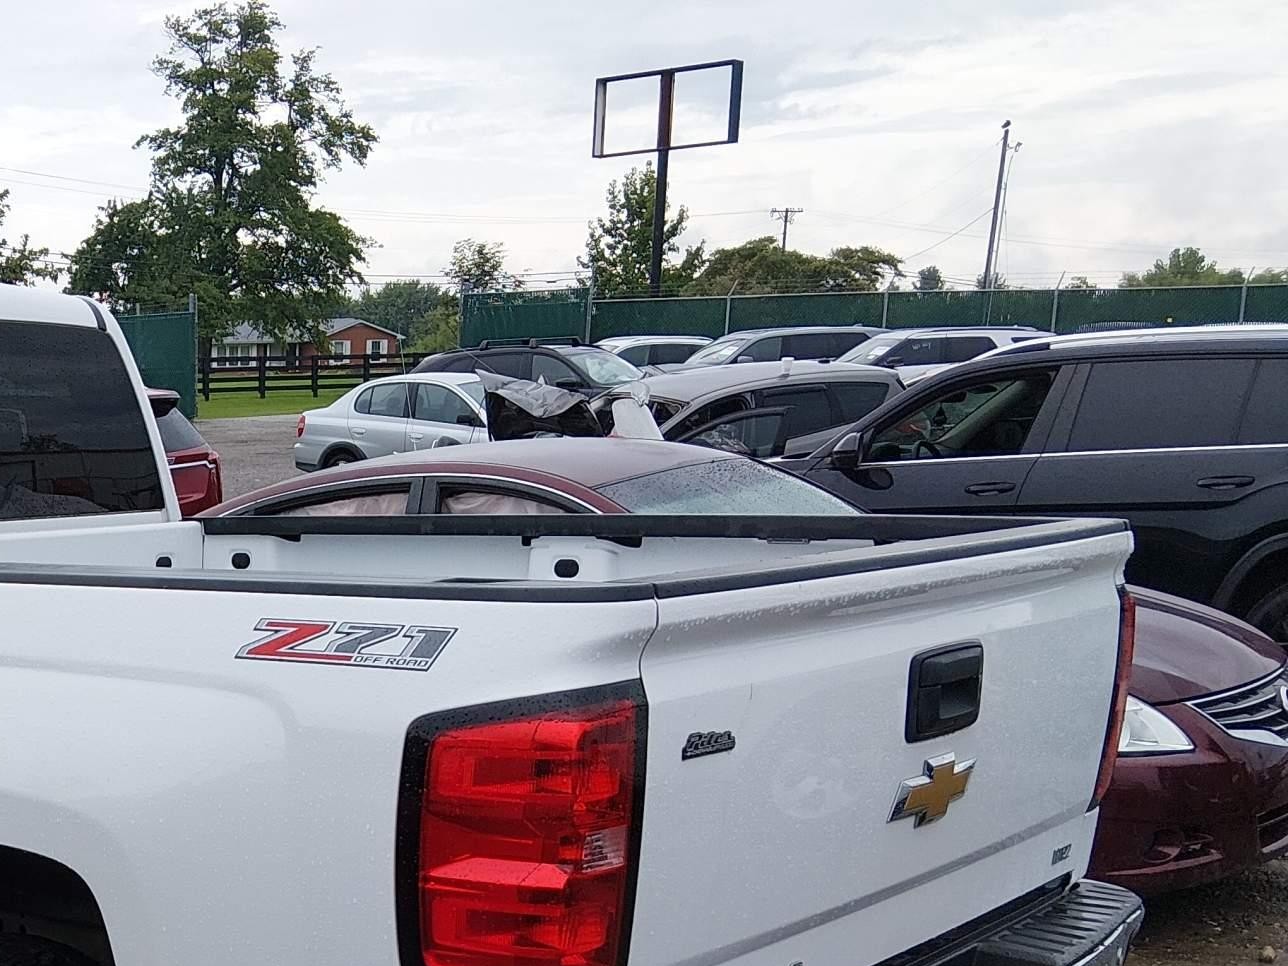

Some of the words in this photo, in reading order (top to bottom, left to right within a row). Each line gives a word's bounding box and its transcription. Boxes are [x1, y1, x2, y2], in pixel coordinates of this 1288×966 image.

[234, 618, 459, 672] Z71
[353, 655, 383, 666] OFF
[385, 657, 430, 668] ROAD
